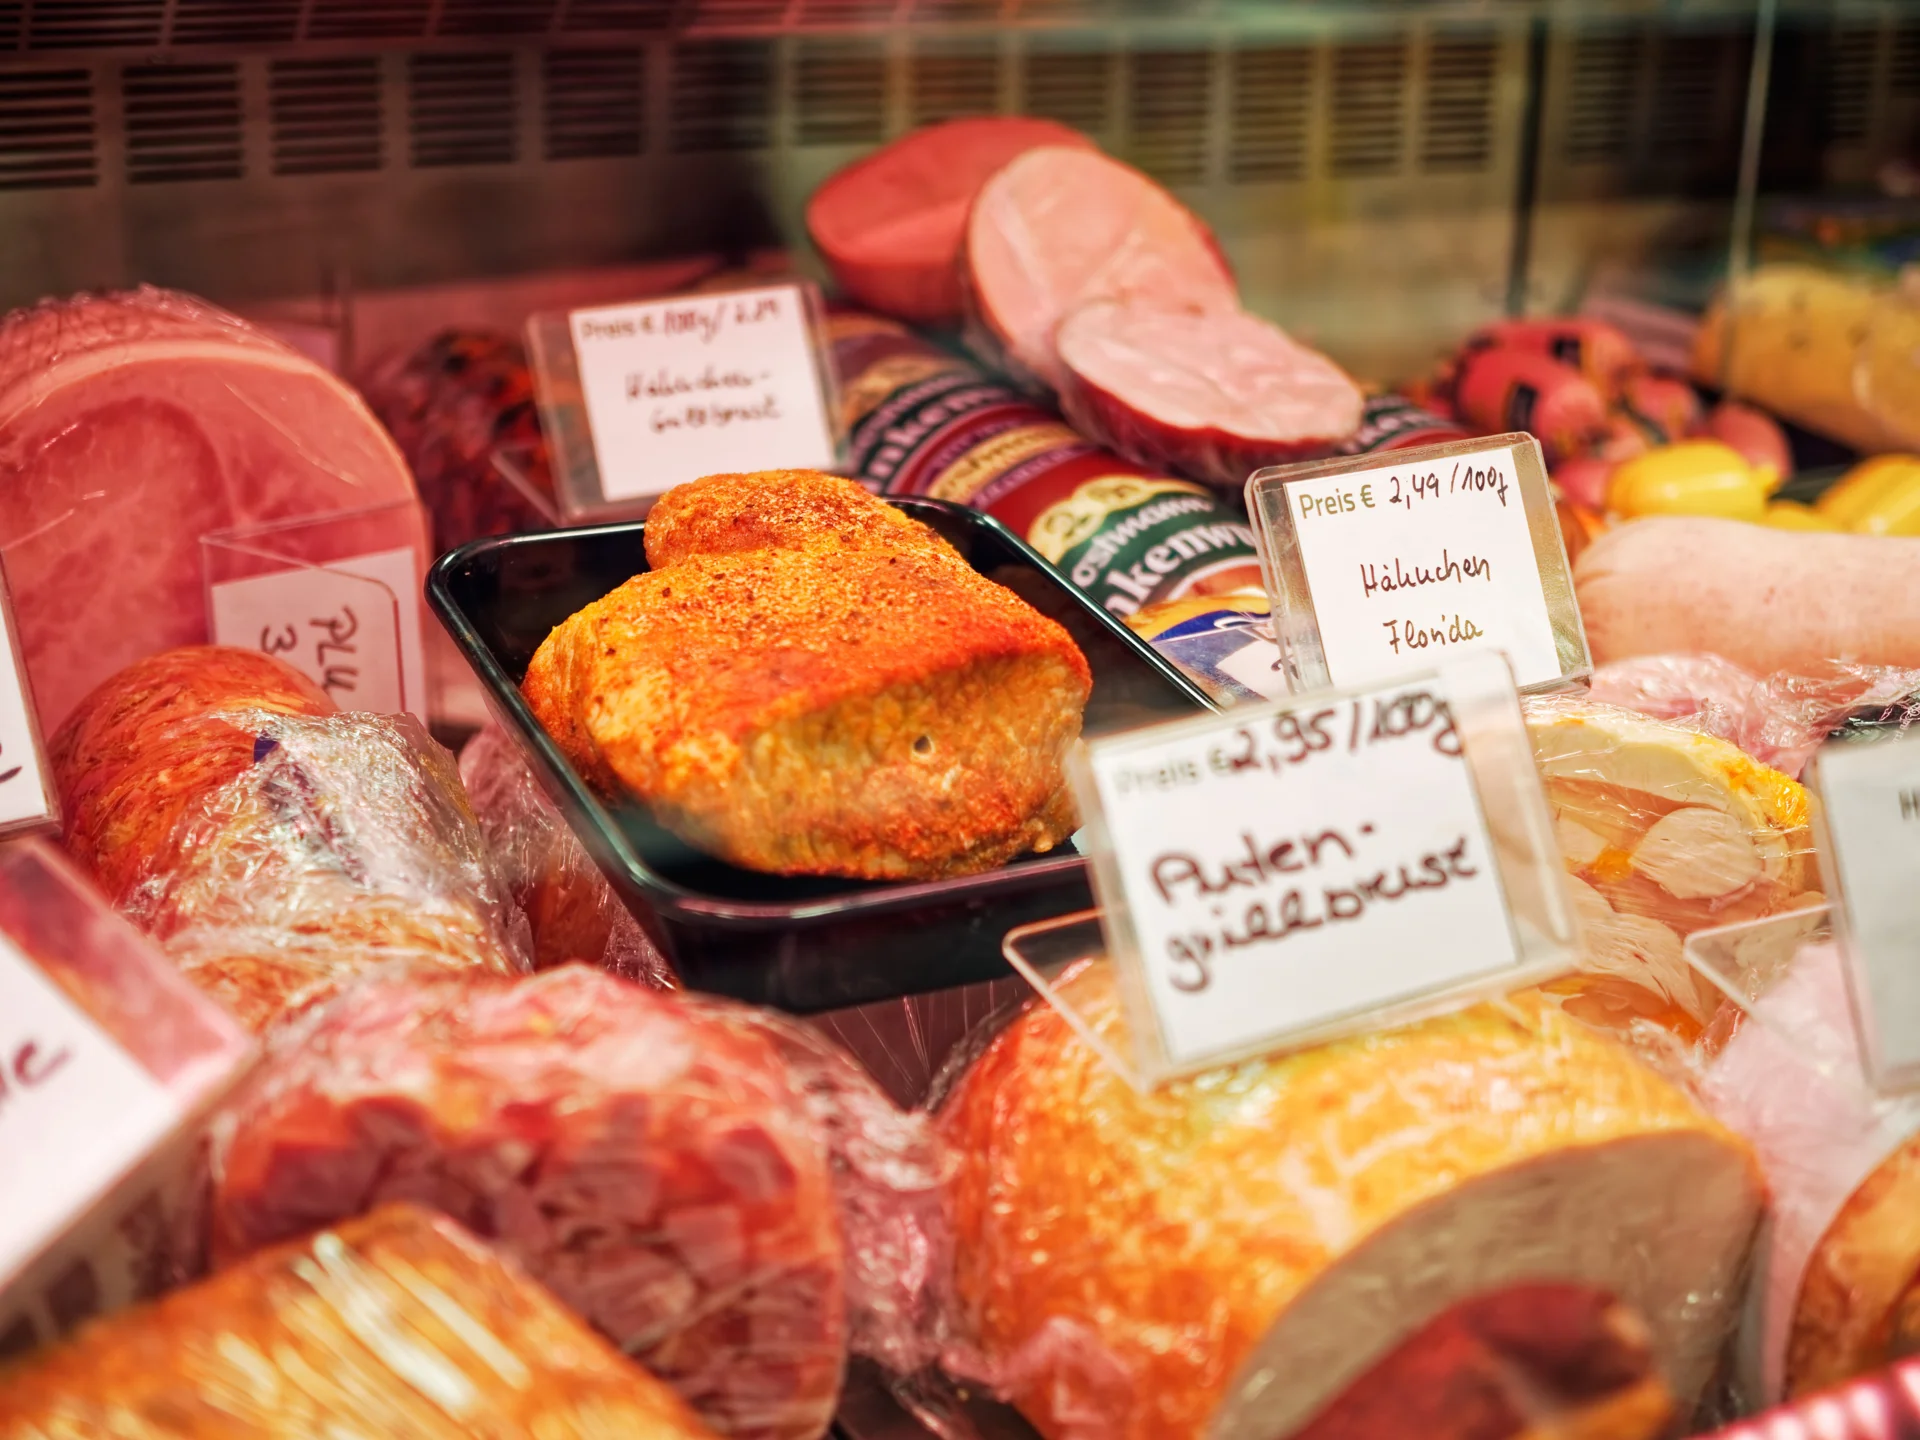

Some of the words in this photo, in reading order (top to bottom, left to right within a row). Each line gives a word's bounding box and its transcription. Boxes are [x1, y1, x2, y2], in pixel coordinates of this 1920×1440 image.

[1299, 488, 1356, 519] Preis
[1360, 484, 1376, 509] €
[1382, 614, 1484, 655] Florida
[1115, 758, 1200, 794] Preis
[1150, 822, 1376, 907] Puten-
